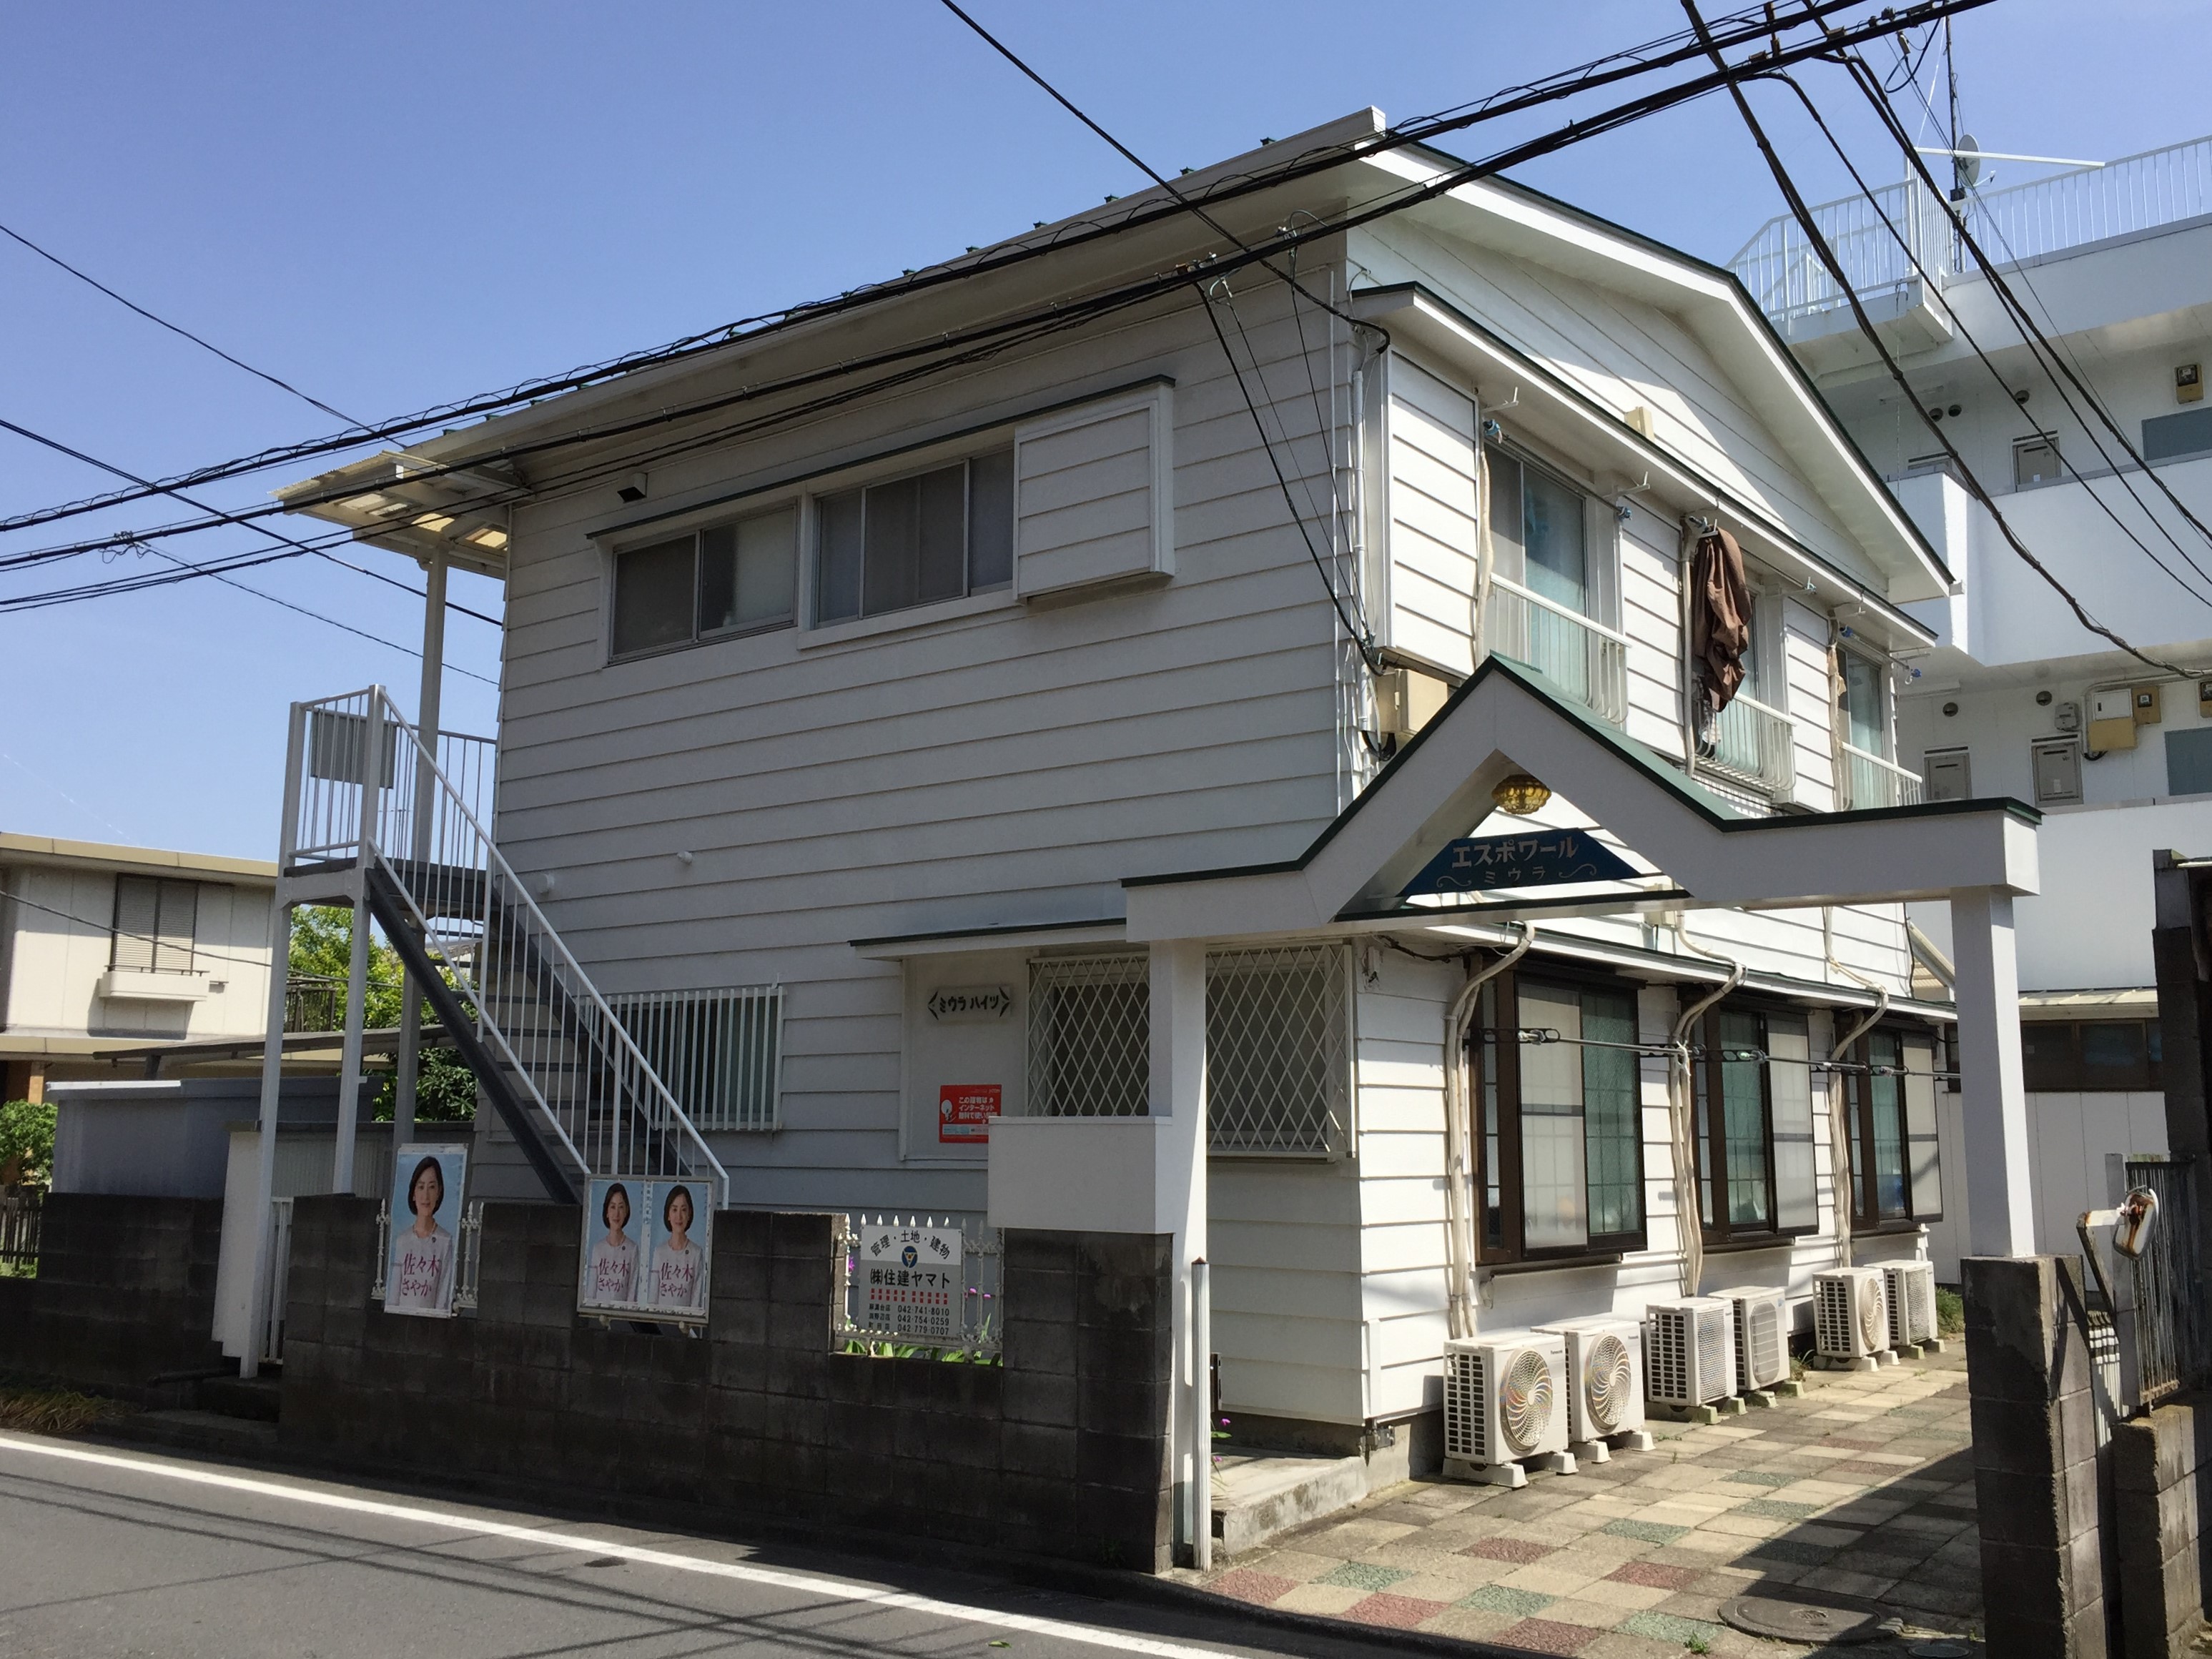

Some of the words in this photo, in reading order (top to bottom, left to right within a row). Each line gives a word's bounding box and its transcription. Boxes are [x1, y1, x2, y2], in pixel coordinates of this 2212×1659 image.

[1451, 836, 1579, 868] エスポワール
[1484, 866, 1546, 885] ミウラ
[404, 1253, 440, 1277] 佐々木
[599, 1258, 629, 1276] 佐々木
[661, 1262, 693, 1282] 佐々木
[402, 1279, 432, 1297] さやか
[598, 1278, 624, 1293] さやか
[660, 1283, 687, 1298] さやか
